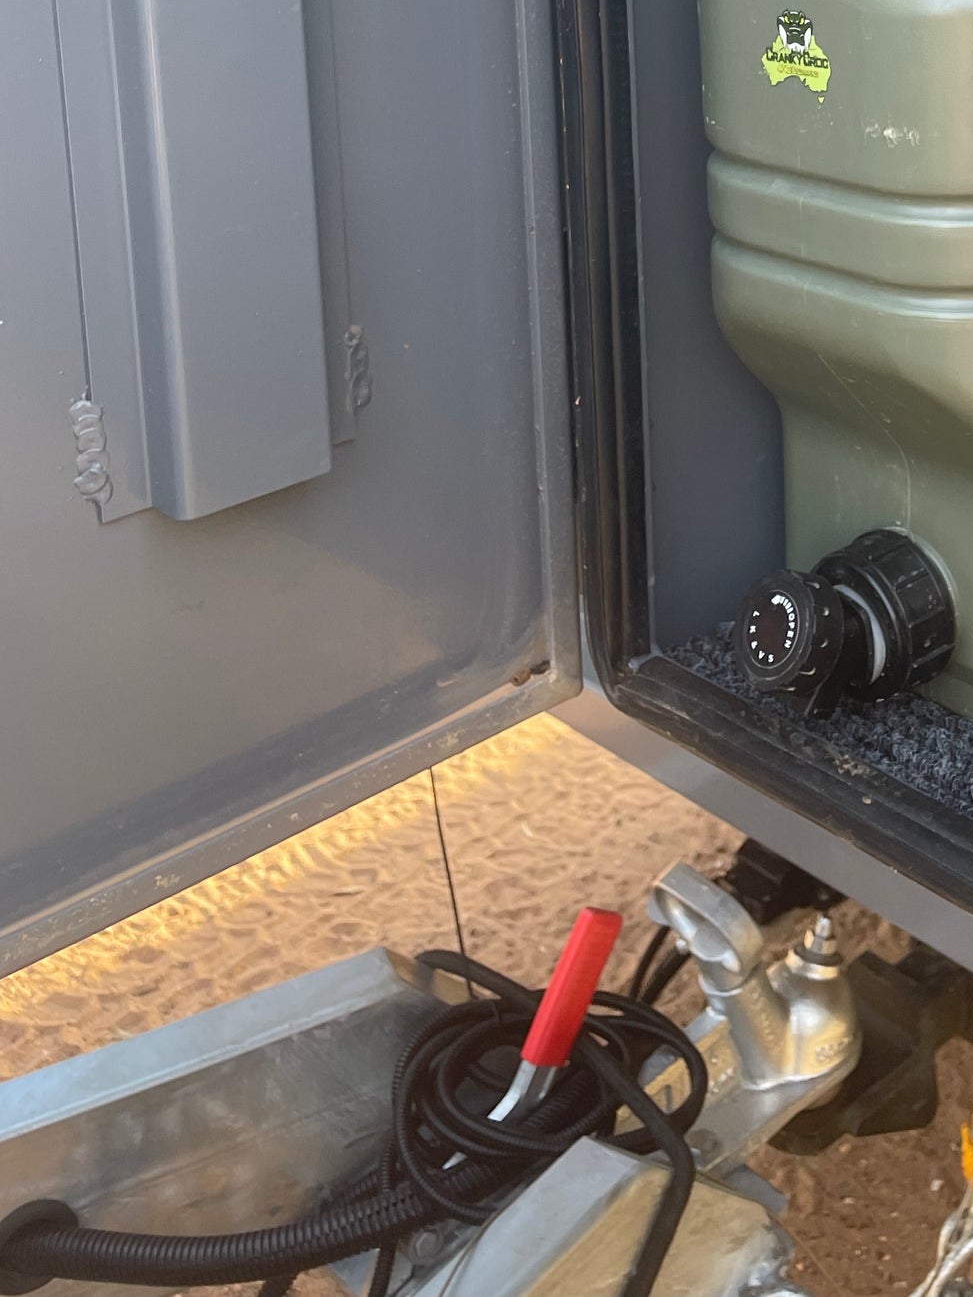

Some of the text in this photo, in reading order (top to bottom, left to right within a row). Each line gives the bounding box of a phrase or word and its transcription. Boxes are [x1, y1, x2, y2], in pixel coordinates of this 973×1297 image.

[766, 47, 829, 69] CRANKY CROC
[784, 613, 796, 649] OPEN
